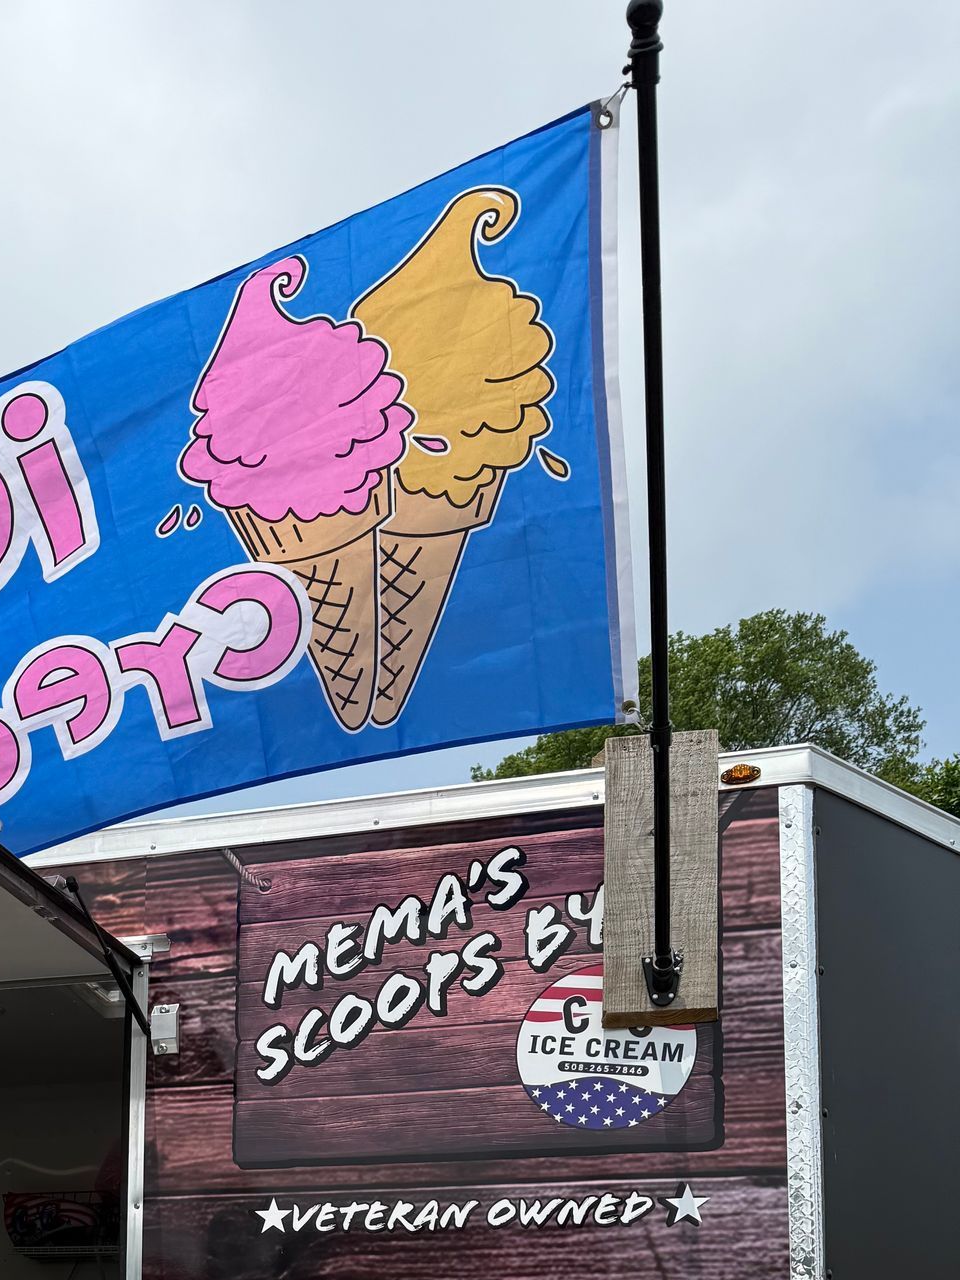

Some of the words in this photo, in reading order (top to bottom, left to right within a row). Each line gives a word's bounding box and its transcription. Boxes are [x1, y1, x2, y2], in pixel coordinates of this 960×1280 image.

[263, 846, 525, 1006] MEMA'S
[255, 933, 498, 1082] SCOOPS
[526, 883, 604, 967] BY
[528, 1035, 575, 1055] ICE
[586, 1038, 684, 1063] CREAM
[564, 1063, 643, 1075] 508-265-7846
[291, 1199, 479, 1233] VETERAN
[487, 1191, 655, 1229] OWNED
